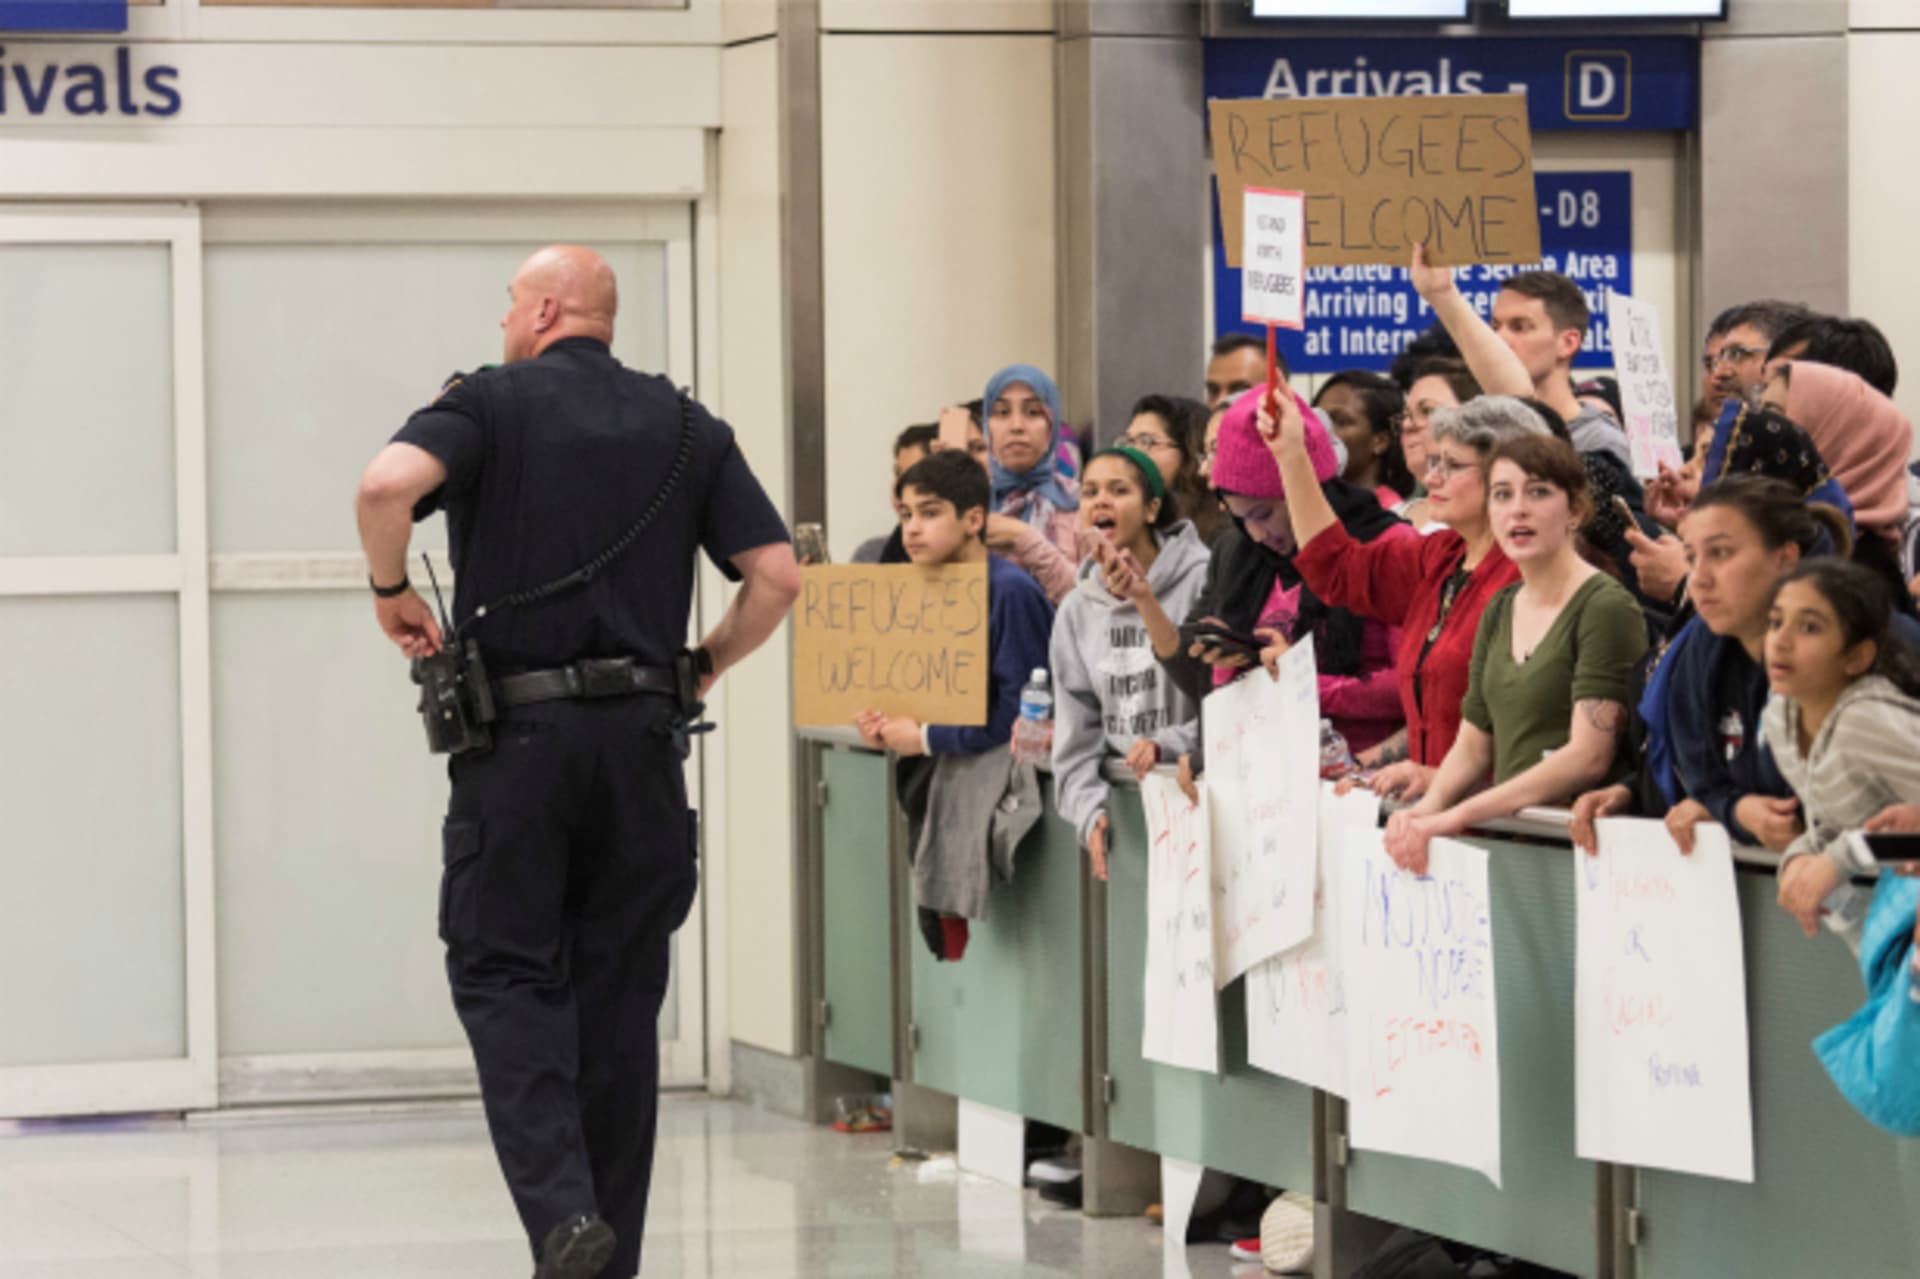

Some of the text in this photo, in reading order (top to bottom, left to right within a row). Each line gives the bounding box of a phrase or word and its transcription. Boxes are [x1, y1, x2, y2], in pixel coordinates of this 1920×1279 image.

[1262, 57, 1483, 99] Arrivals
[1579, 62, 1615, 108] D
[1227, 110, 1527, 178] REFUGEES
[1302, 194, 1517, 259] ELCOME
[1563, 250, 1619, 279] Area
[1304, 286, 1409, 325] Arriving
[1304, 326, 1332, 356] at
[804, 576, 983, 638] REFUGEES
[817, 646, 977, 696] WELCOME
